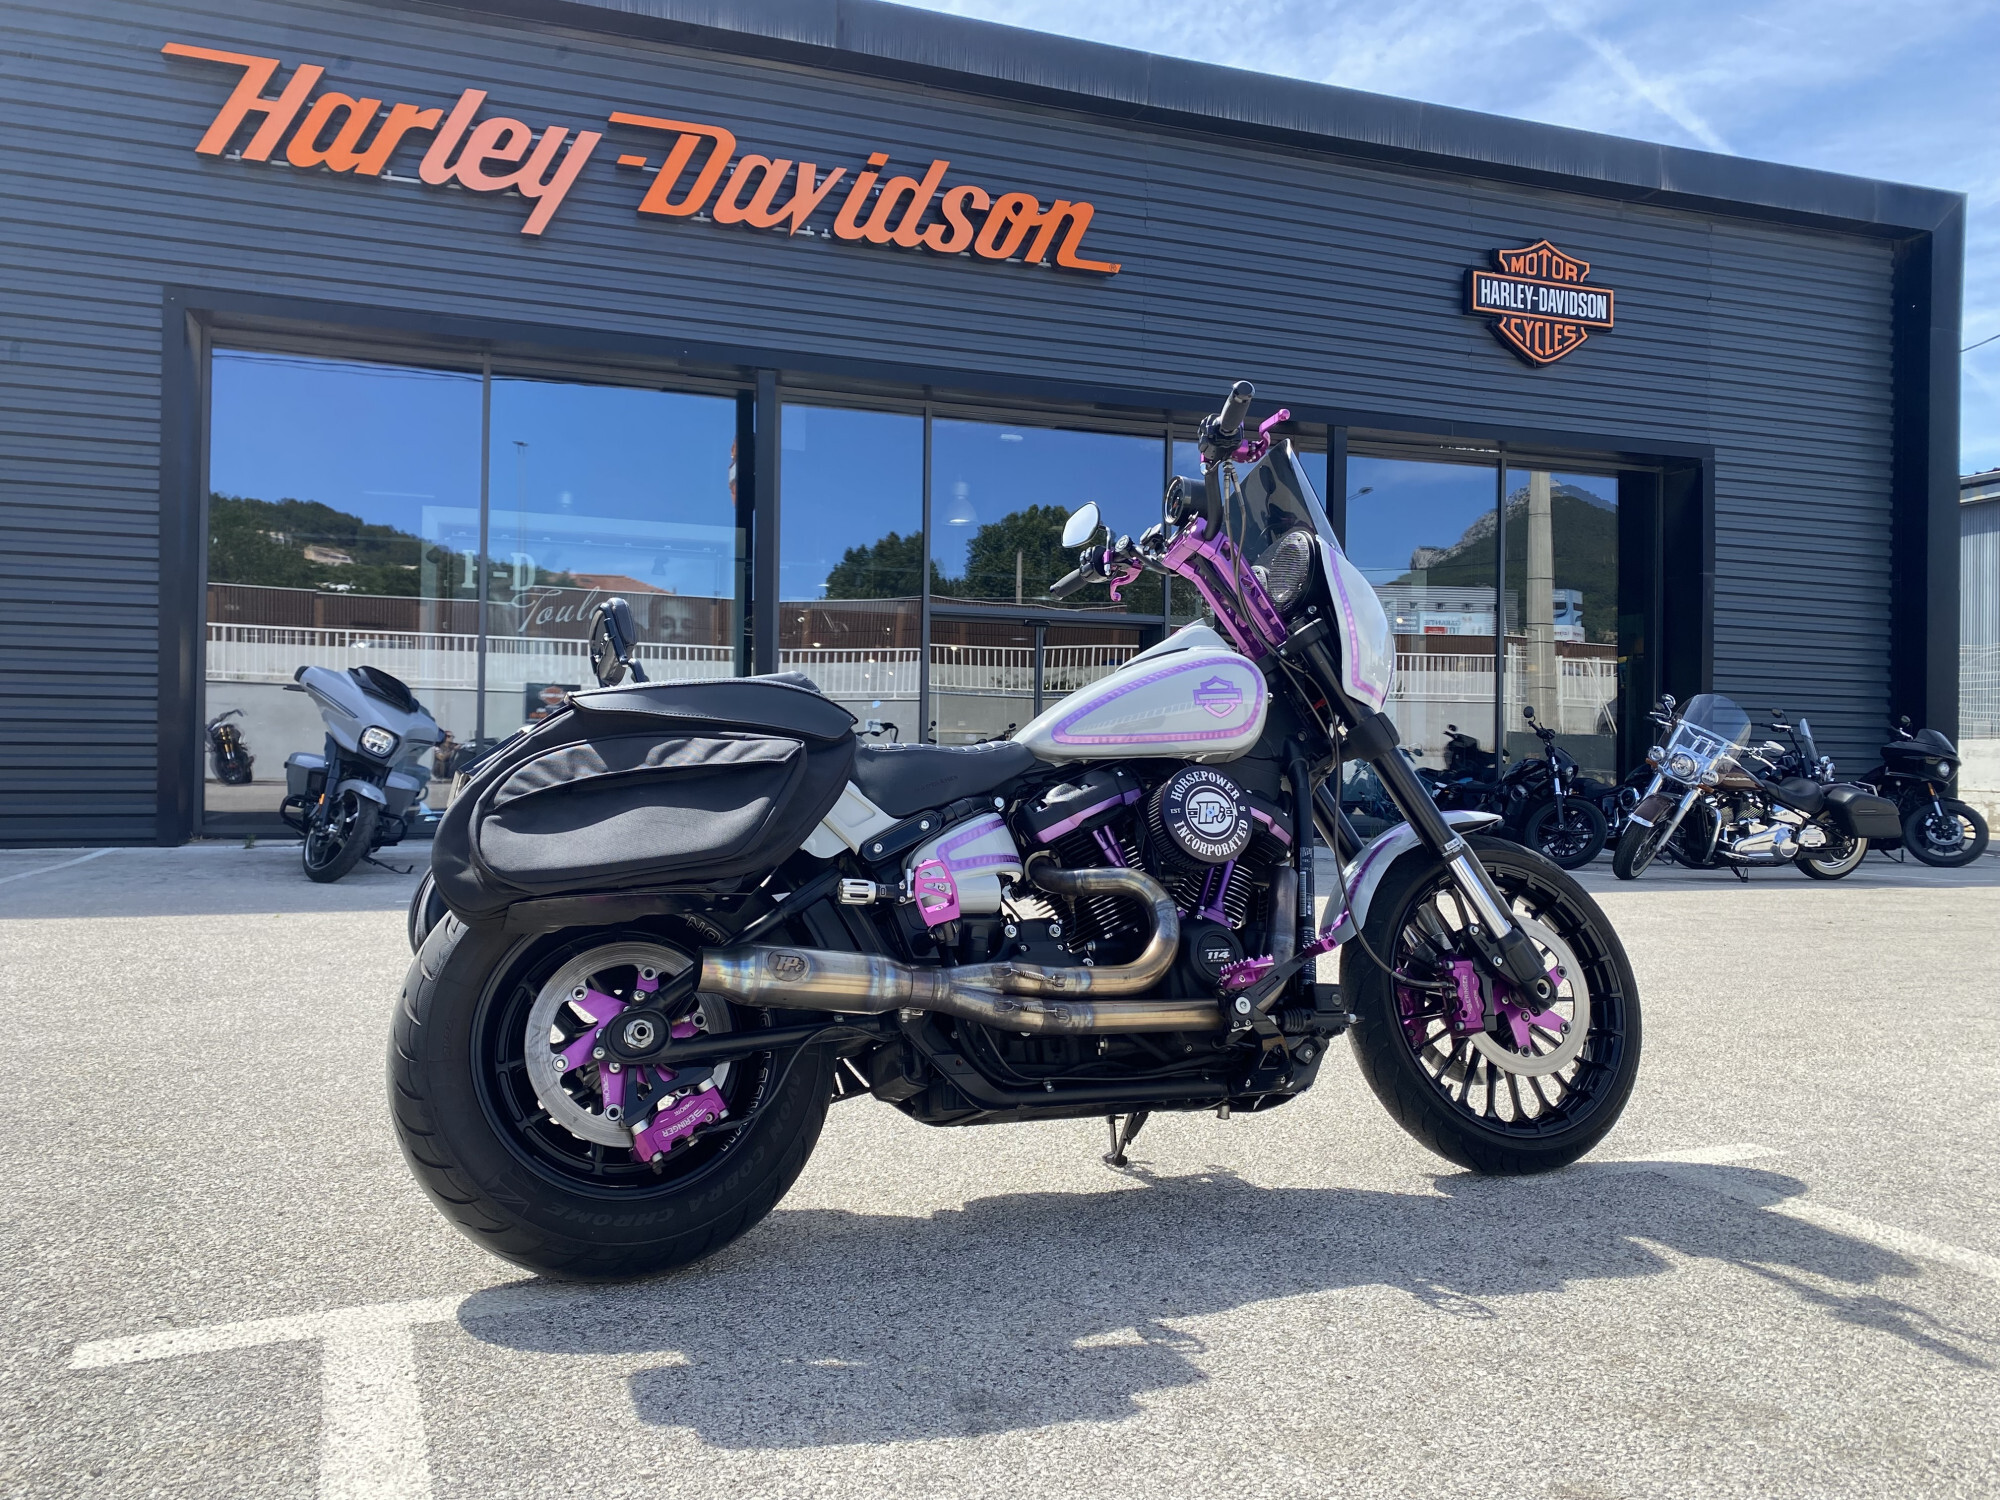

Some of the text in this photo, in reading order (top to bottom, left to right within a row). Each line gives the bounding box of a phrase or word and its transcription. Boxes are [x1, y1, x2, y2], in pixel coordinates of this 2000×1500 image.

[1510, 248, 1578, 282] MOTOR
[1480, 278, 1607, 320] HARLEY-DAVIDSON
[1509, 317, 1577, 356] CYCLES
[1170, 771, 1240, 802] HORSEPOWER
[1174, 819, 1249, 857] INCORPORATED
[1207, 951, 1230, 960] 114
[661, 1108, 707, 1138] BERINGER
[542, 1203, 677, 1229] CHROME
